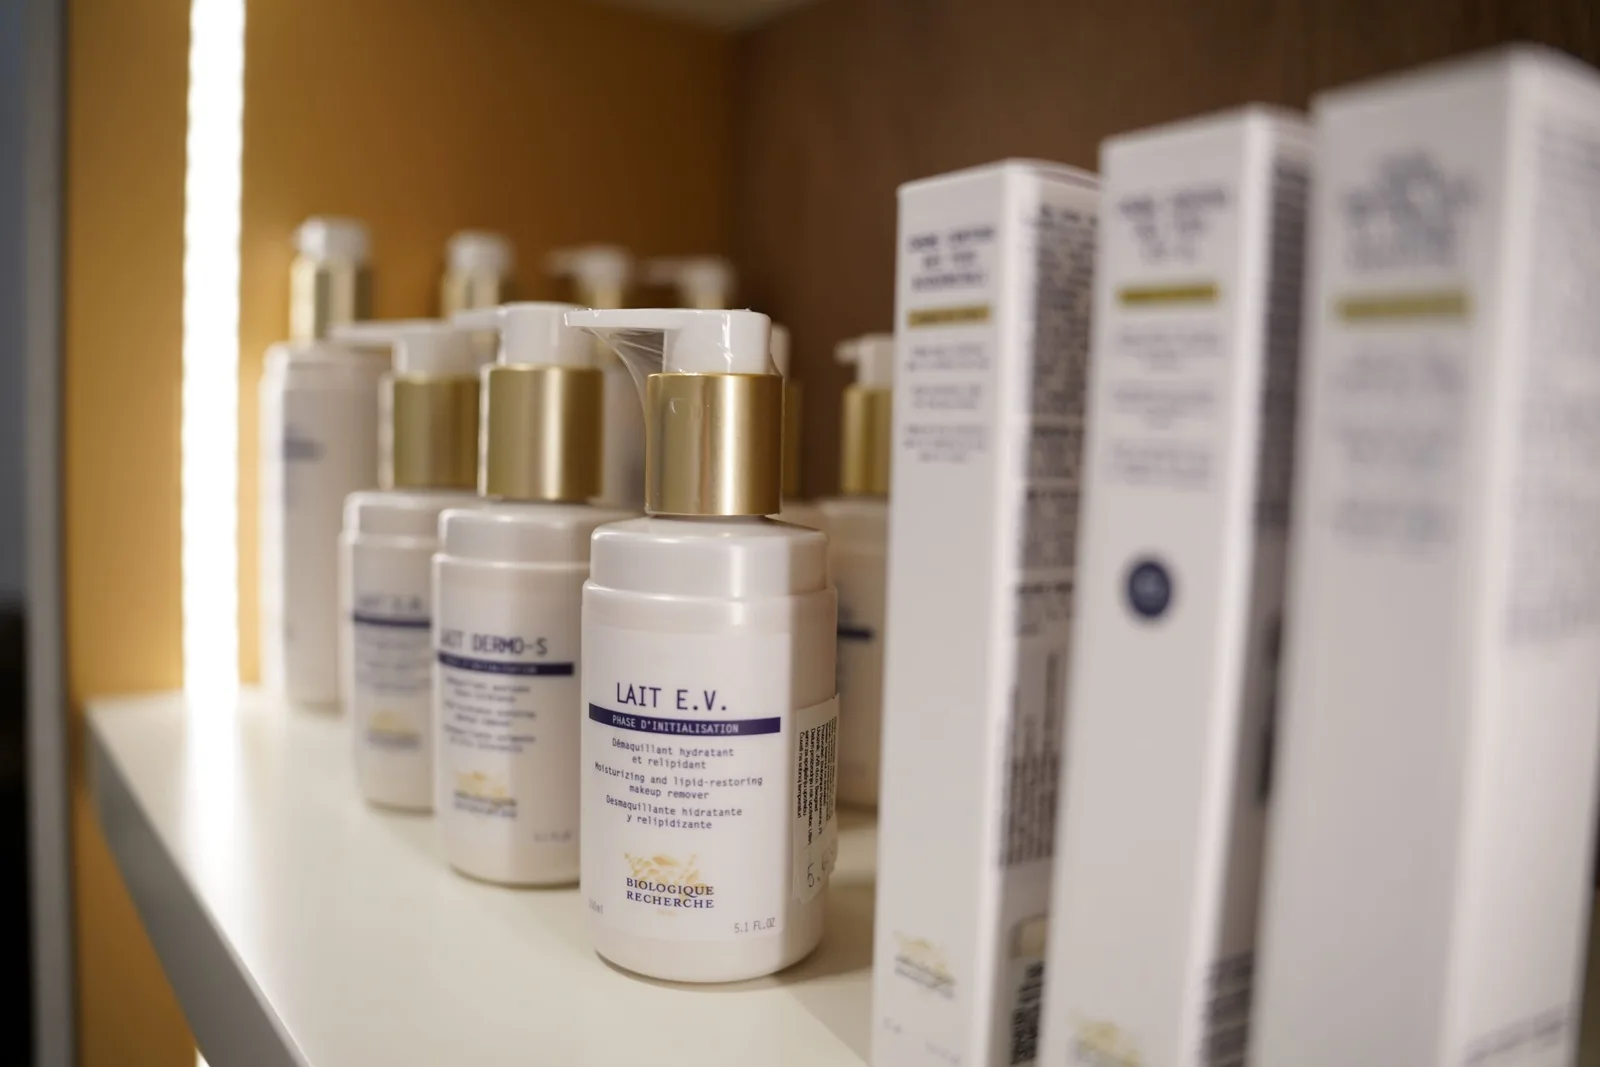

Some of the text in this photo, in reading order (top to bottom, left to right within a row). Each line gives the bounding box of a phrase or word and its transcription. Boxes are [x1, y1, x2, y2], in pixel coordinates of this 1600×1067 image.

[472, 632, 548, 657] DERMO-S
[616, 682, 727, 711] LAIT E.V.
[612, 714, 739, 734] PHASE D'INITIALISATION
[612, 737, 735, 757] Démaquillant hydratant
[632, 755, 707, 770] et relipidant
[594, 761, 763, 788] Moisturizing and lipid-restoring
[629, 784, 710, 800] makeup remover
[606, 794, 743, 817] Desmaquillante hidratante
[626, 814, 713, 829] y relipidizante
[626, 877, 715, 898] BIOLOGIQUE
[626, 890, 715, 909] RECHERCHE
[734, 922, 748, 934] 5.1
